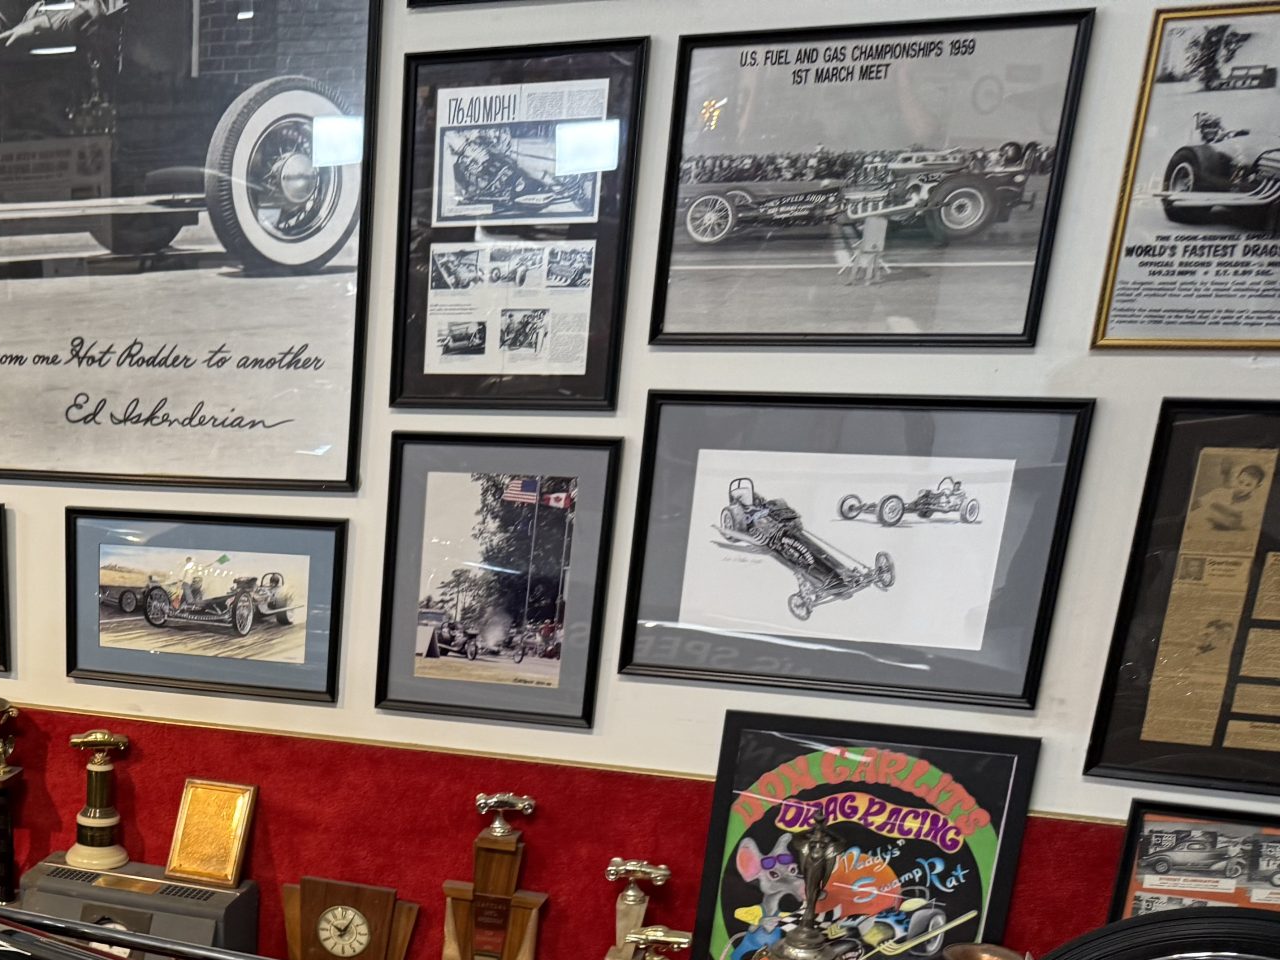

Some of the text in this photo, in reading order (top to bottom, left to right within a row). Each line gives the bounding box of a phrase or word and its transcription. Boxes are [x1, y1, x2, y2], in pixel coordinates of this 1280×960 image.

[739, 38, 976, 67] U.S. FUEL AND GAS CHAMPIONSHIPS 1959
[791, 63, 891, 85] 1ST MARCH MEET
[448, 98, 481, 125] 176.40
[483, 94, 517, 122] MPH!
[1125, 244, 1237, 258] WORLD'S FASTEST
[32, 352, 62, 365] one
[64, 336, 116, 368] Hot
[116, 338, 198, 368] Rodder
[203, 343, 233, 369] to
[236, 343, 326, 371] another
[65, 393, 295, 429] Ed Iskenderian
[731, 747, 991, 836] DON GARLITS
[777, 794, 962, 851] DRAG RACING
[851, 857, 970, 902] Swamp Rat
